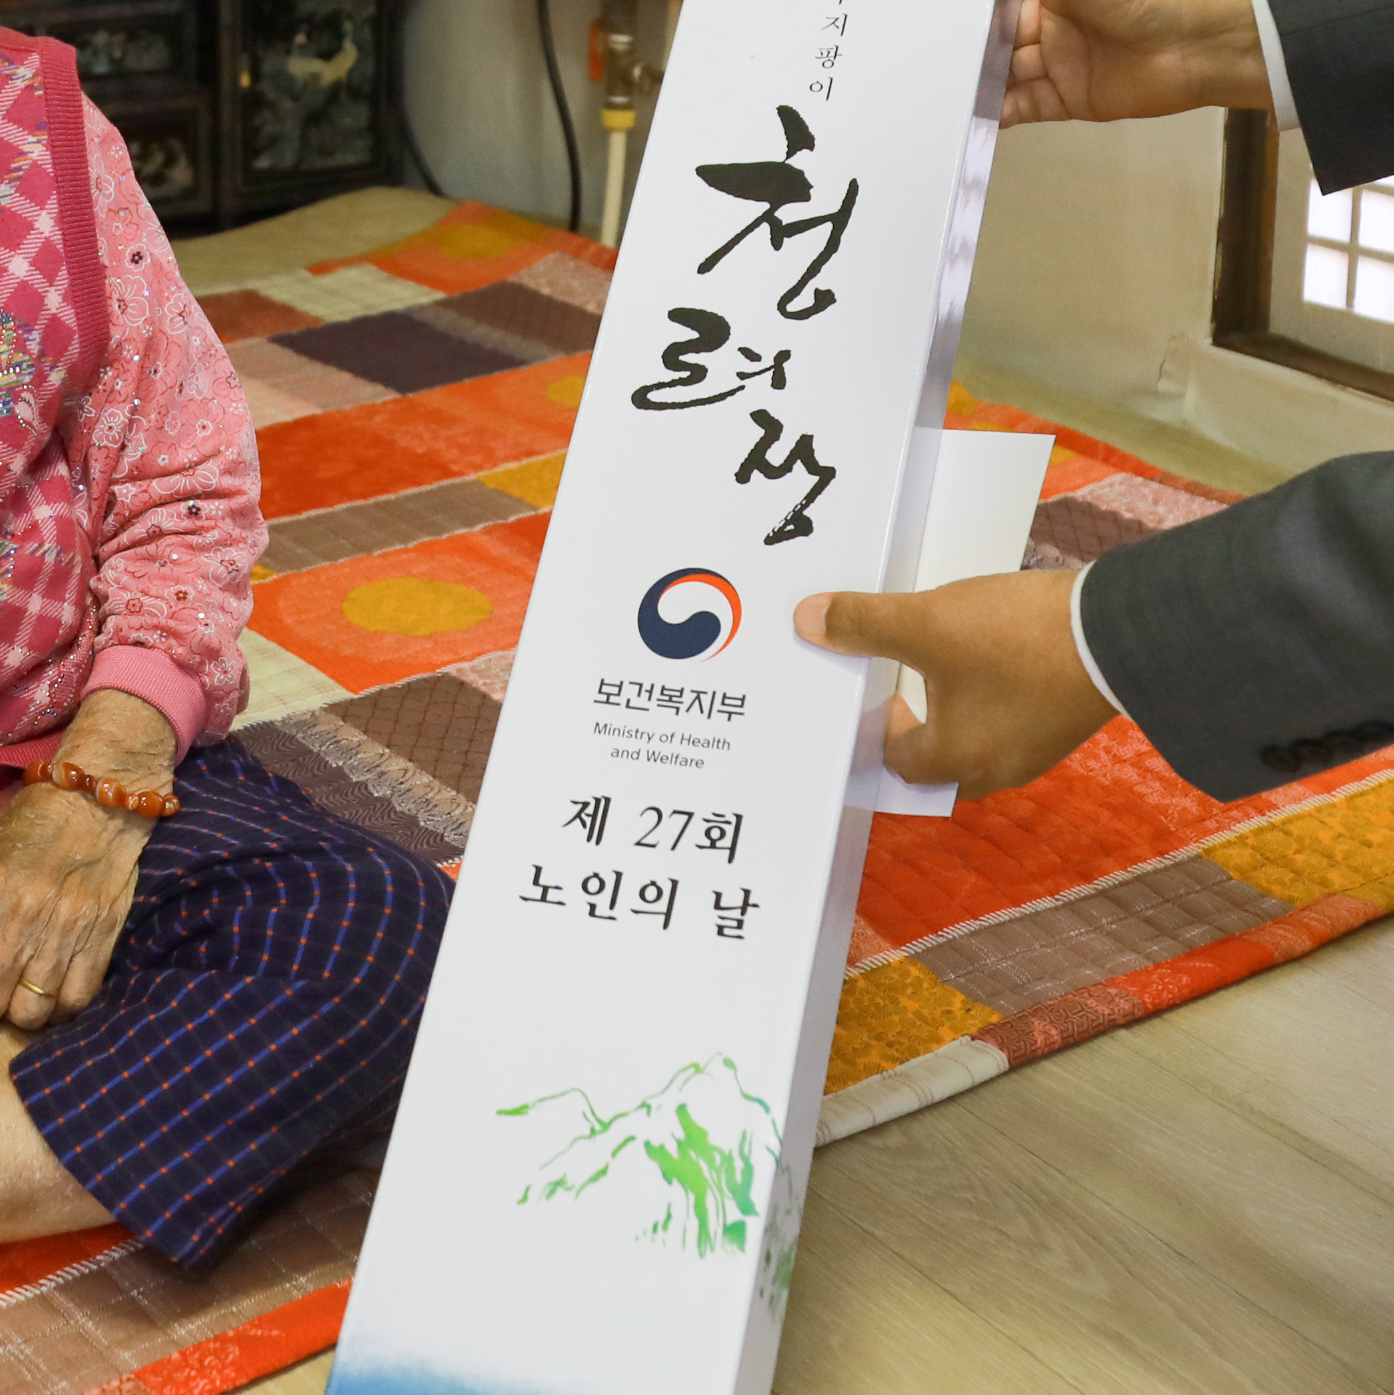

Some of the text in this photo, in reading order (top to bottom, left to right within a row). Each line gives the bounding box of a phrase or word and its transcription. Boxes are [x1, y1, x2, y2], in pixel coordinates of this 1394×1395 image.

[593, 678, 747, 722] 보건복지부
[593, 721, 732, 752] Ministry of Health
[609, 746, 706, 769] and Welfare
[561, 794, 745, 864] 제 27회
[518, 863, 761, 940] 노인의 날
